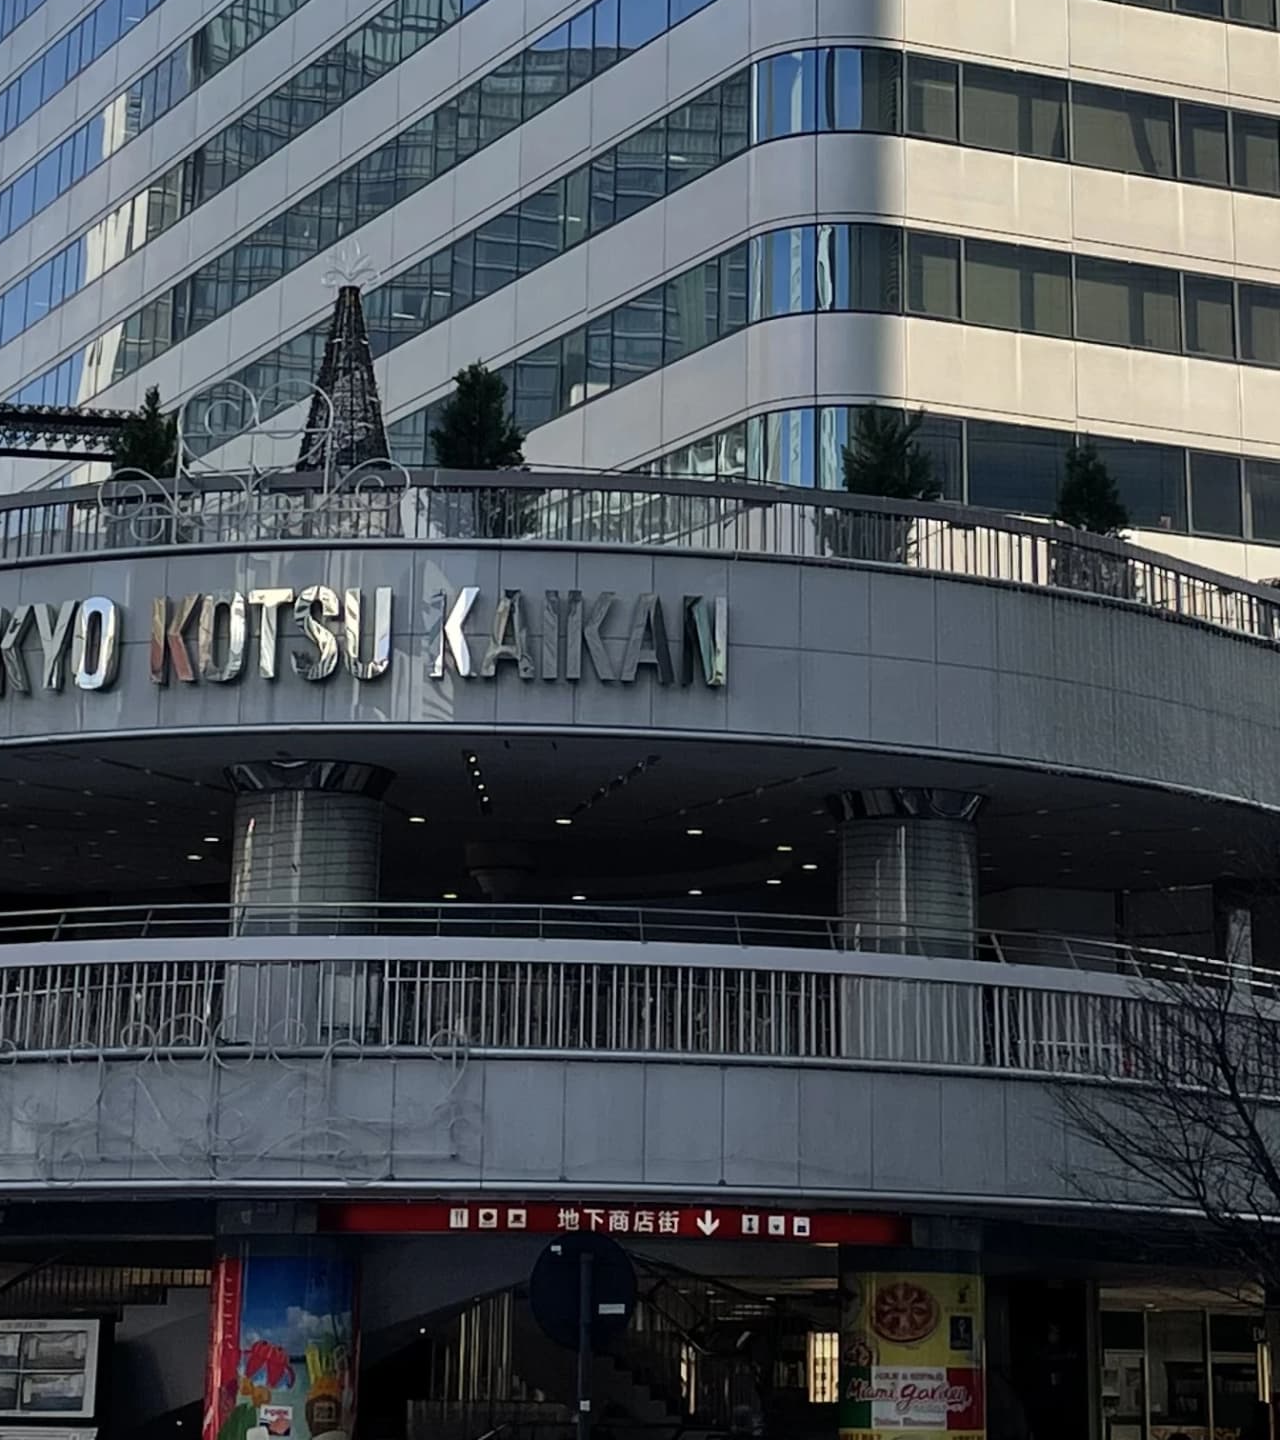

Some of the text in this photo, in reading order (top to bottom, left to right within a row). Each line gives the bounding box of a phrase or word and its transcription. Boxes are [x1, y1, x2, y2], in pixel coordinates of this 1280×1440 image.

[150, 585, 394, 687] KOTSU
[429, 586, 728, 688] KAIKAN
[556, 1207, 680, 1233] 地下商店街
